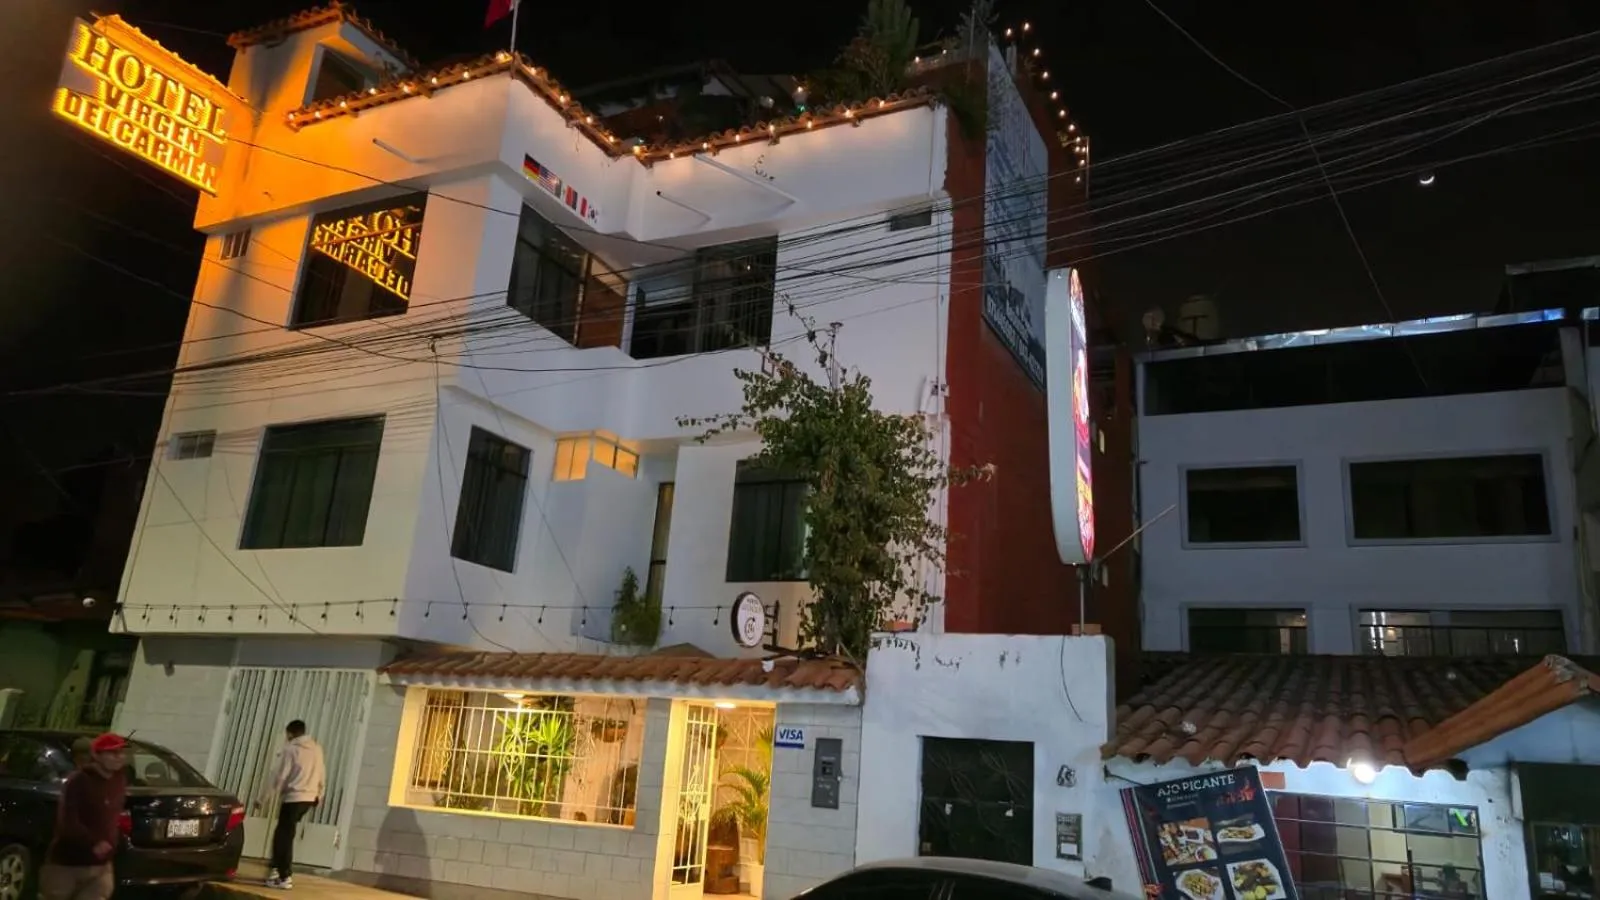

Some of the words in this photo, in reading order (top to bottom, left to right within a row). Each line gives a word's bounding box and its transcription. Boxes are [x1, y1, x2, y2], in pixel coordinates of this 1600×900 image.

[69, 23, 228, 144] HOTEL
[98, 79, 204, 158] VIRGEN
[778, 727, 804, 741] VISA
[1157, 783, 1181, 798] AJO
[1182, 773, 1236, 791] PICANTE
